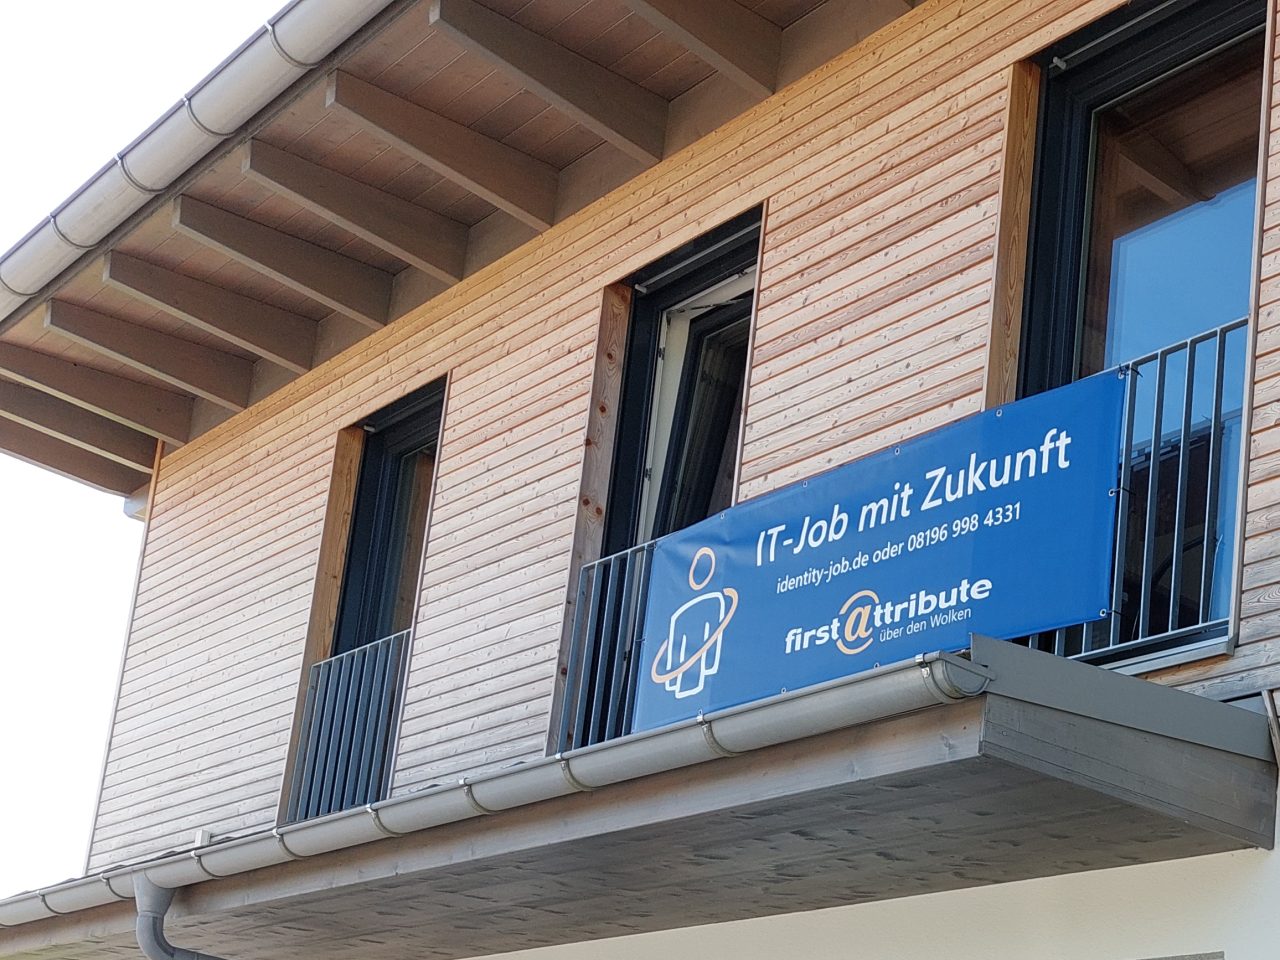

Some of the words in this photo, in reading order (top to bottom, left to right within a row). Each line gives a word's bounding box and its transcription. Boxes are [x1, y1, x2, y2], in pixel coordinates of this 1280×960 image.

[756, 504, 849, 566] IT-Job
[858, 482, 913, 532] mit
[920, 428, 1071, 511] Zukunft
[776, 551, 869, 594] identity-job.de
[873, 541, 904, 564] oder
[907, 524, 948, 552] 08196
[951, 513, 979, 538] 998
[983, 501, 1021, 527] 4331
[785, 578, 993, 655] first@ttribute
[879, 625, 906, 643] über
[906, 620, 927, 635] den
[930, 607, 972, 629] Wolken
